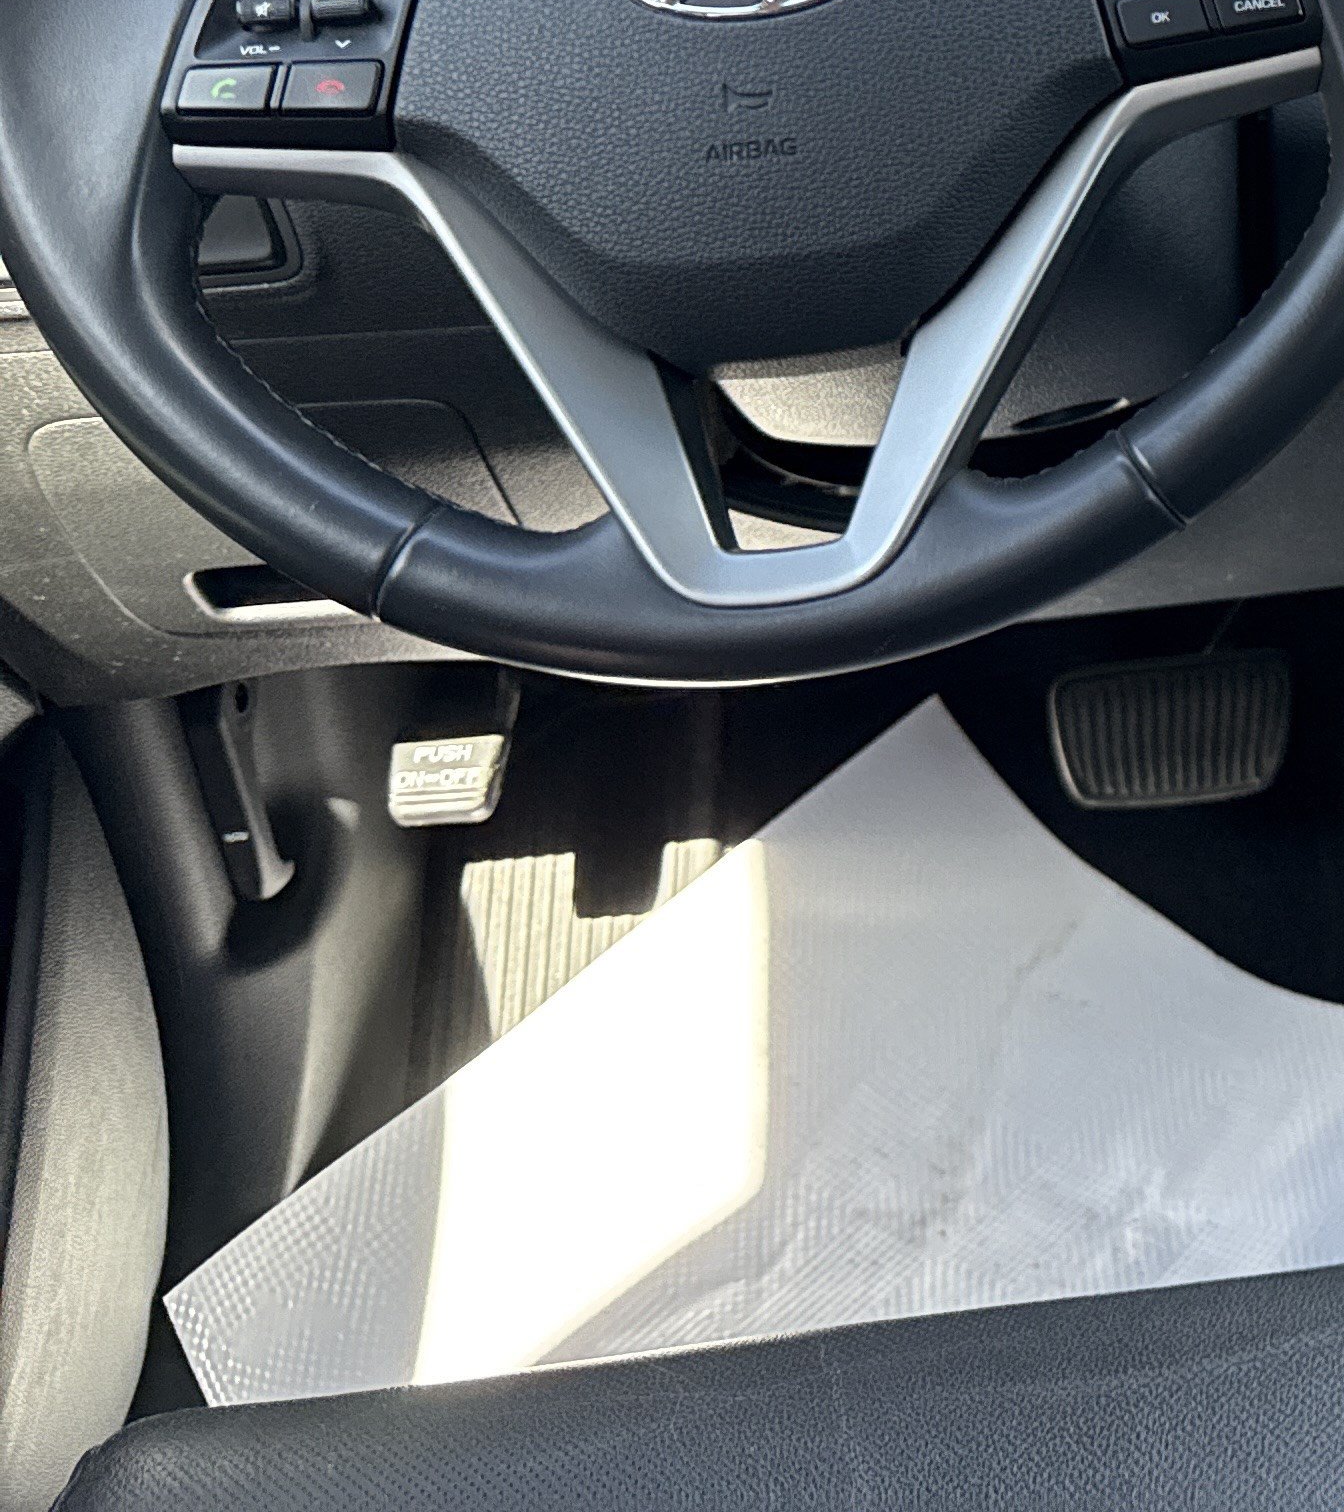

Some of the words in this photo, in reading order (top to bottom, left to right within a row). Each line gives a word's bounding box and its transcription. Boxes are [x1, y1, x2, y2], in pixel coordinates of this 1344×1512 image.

[1151, 11, 1170, 24] OK
[706, 138, 799, 164] AIRBAG
[413, 743, 473, 764] PUSH
